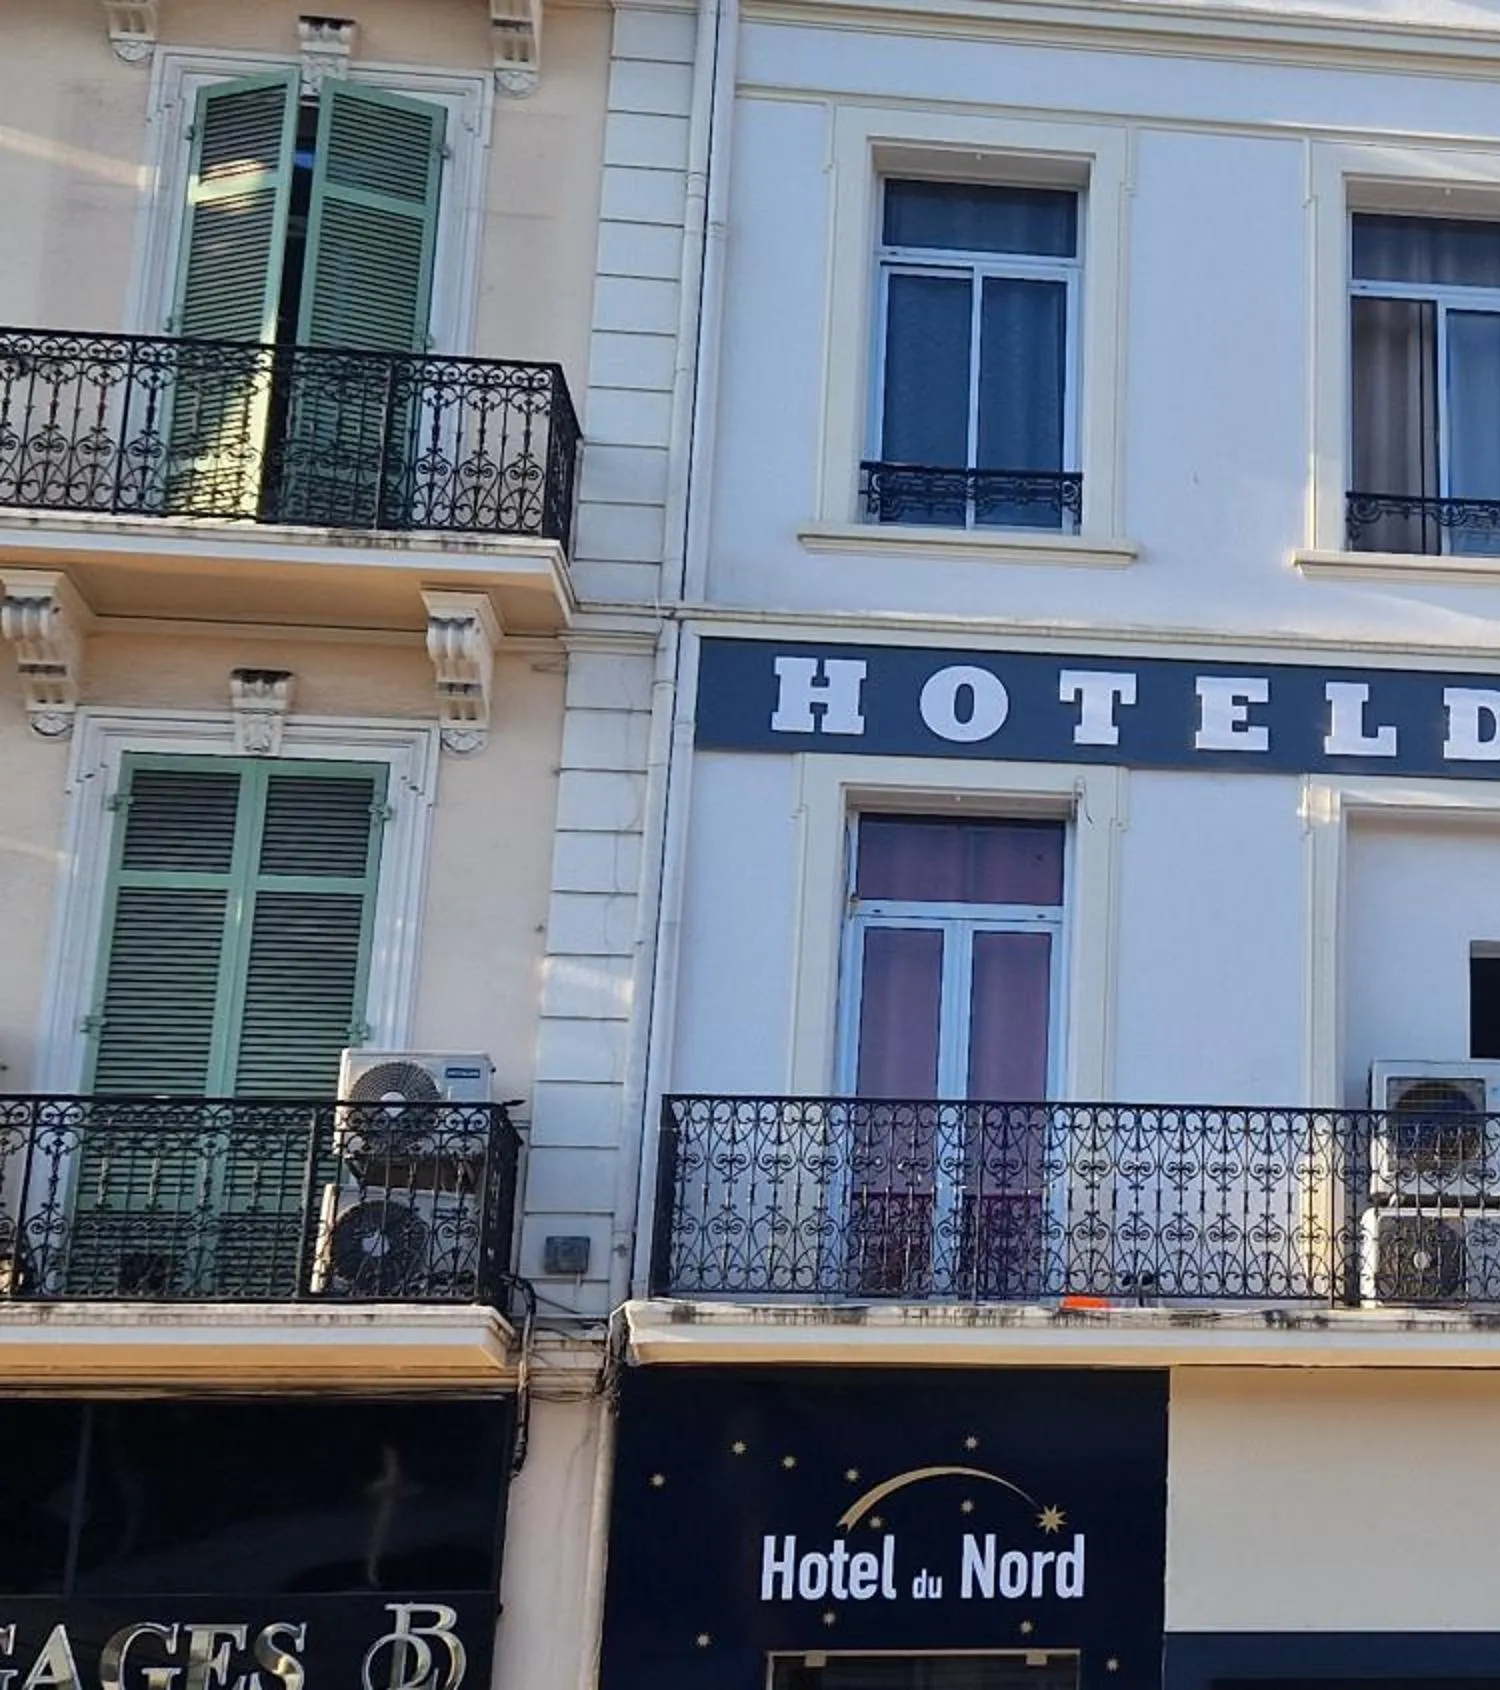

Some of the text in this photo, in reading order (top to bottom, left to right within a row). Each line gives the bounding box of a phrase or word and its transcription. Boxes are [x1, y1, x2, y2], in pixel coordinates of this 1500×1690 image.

[771, 657, 1397, 757] HOTEL
[760, 1533, 1086, 1601] Hotel du Nord
[0, 1622, 307, 1690] AGES
